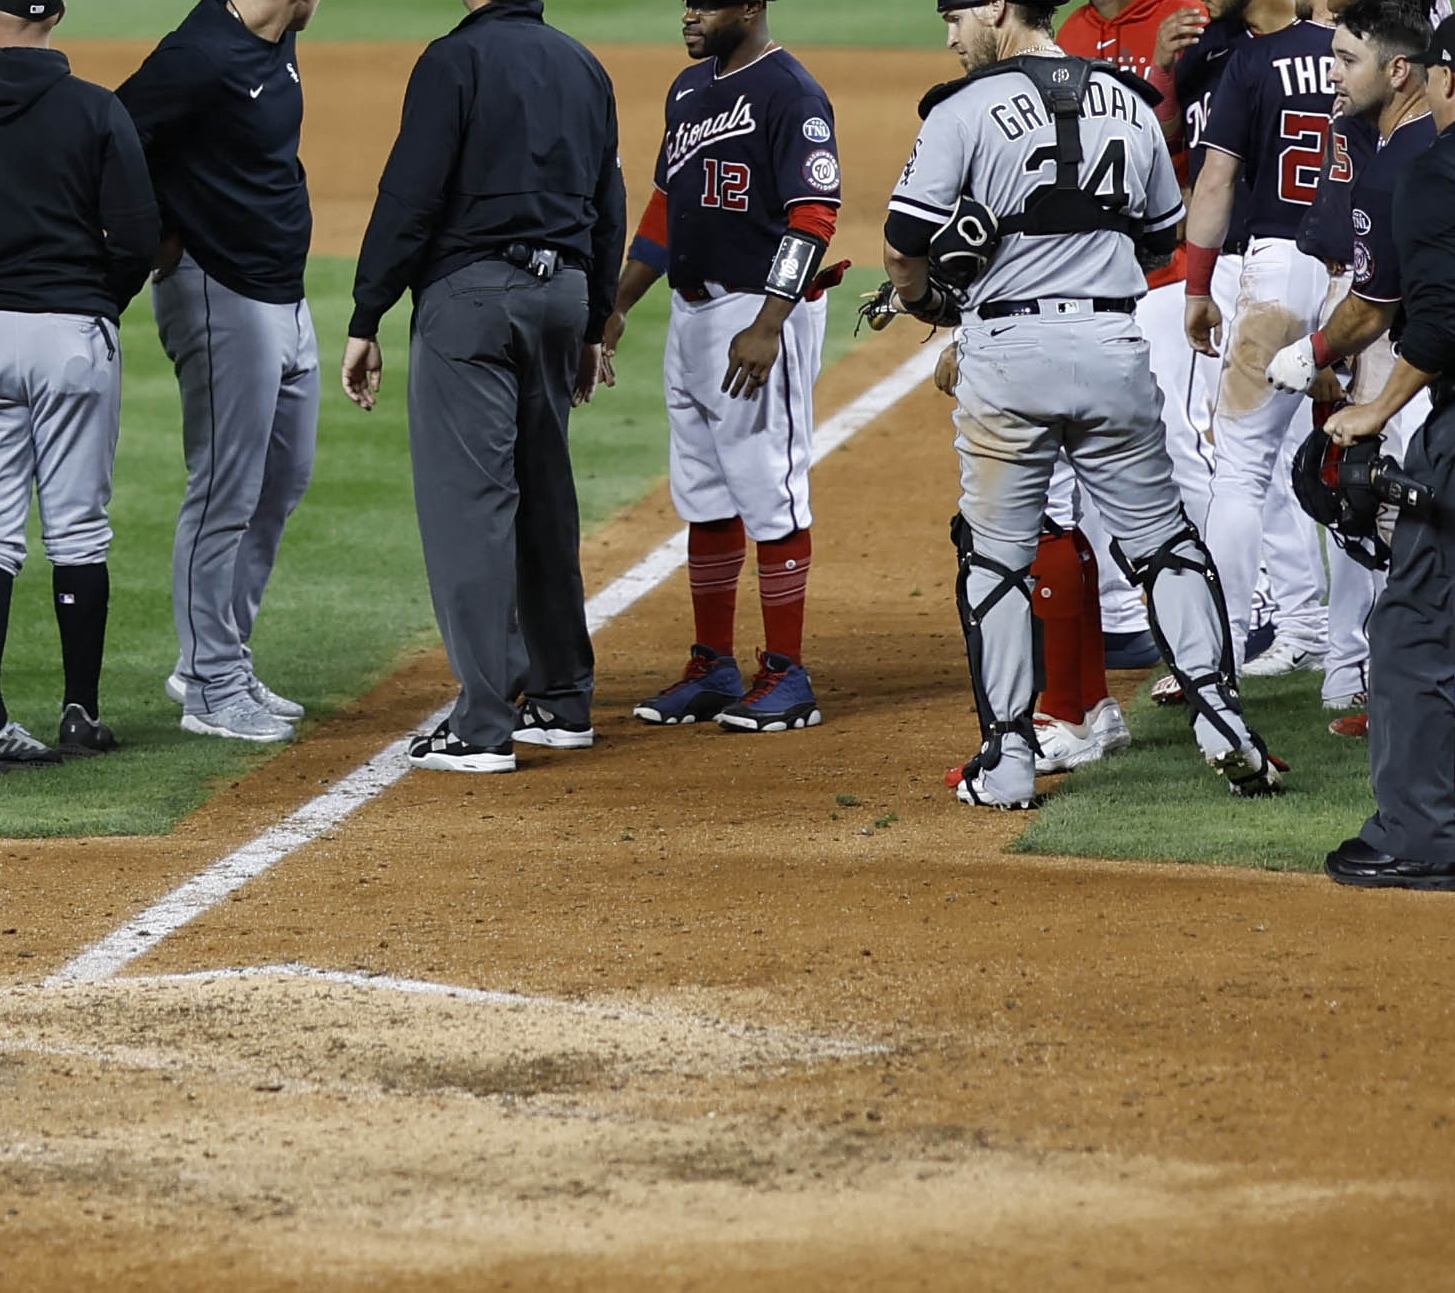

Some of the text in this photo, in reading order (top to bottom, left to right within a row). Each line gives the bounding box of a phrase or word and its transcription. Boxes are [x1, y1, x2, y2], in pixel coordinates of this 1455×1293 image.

[804, 124, 831, 140] TNL
[989, 80, 1145, 143] GRDAL
[700, 158, 752, 213] 12
[1328, 133, 1354, 183] 5
[1022, 136, 1131, 238] 24
